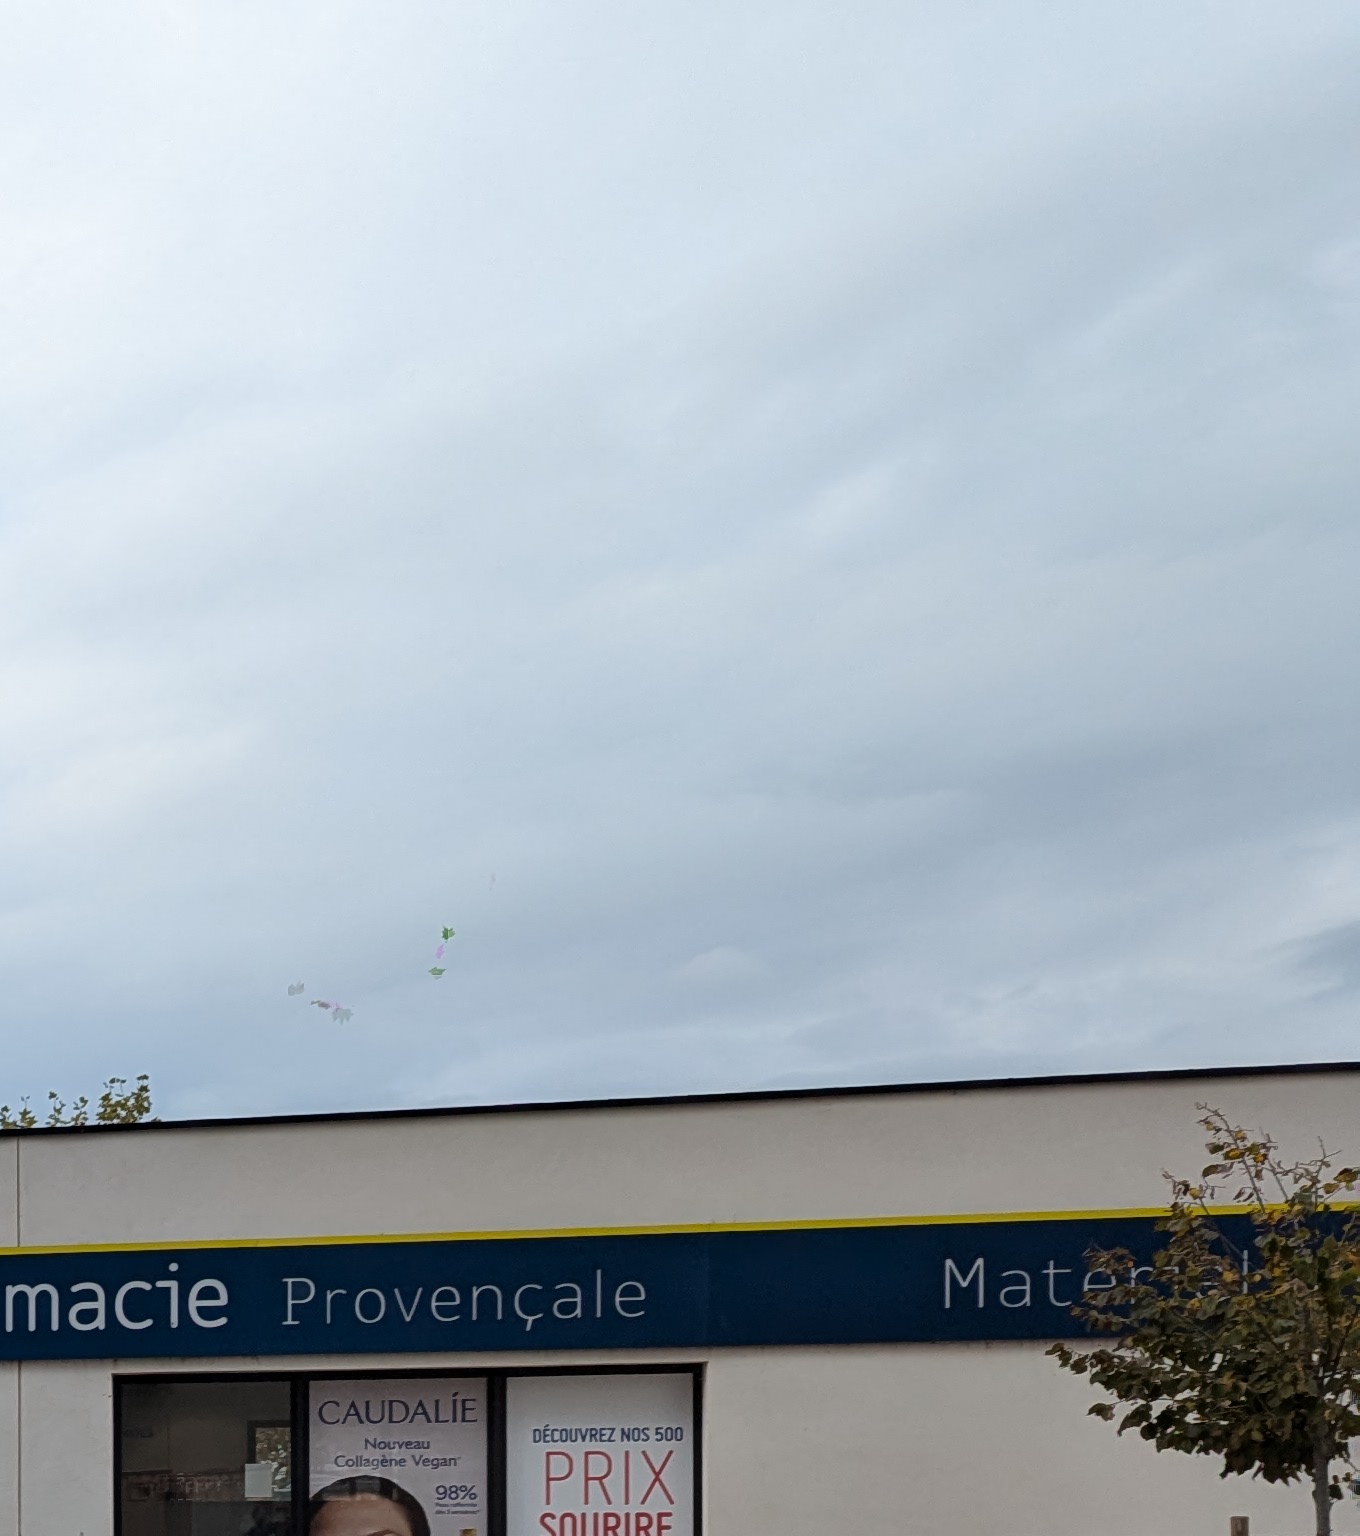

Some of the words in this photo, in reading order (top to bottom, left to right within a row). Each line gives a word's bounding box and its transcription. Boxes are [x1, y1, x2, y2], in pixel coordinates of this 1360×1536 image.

[281, 1268, 647, 1332] Provençale
[532, 1424, 616, 1443] DÉCOUVREZ
[620, 1427, 650, 1443] NOS
[655, 1426, 684, 1442] 500
[363, 1437, 431, 1450] Nouveau
[333, 1455, 407, 1470] Collagène
[544, 1449, 675, 1506] PRIX
[435, 1484, 478, 1500] 98%
